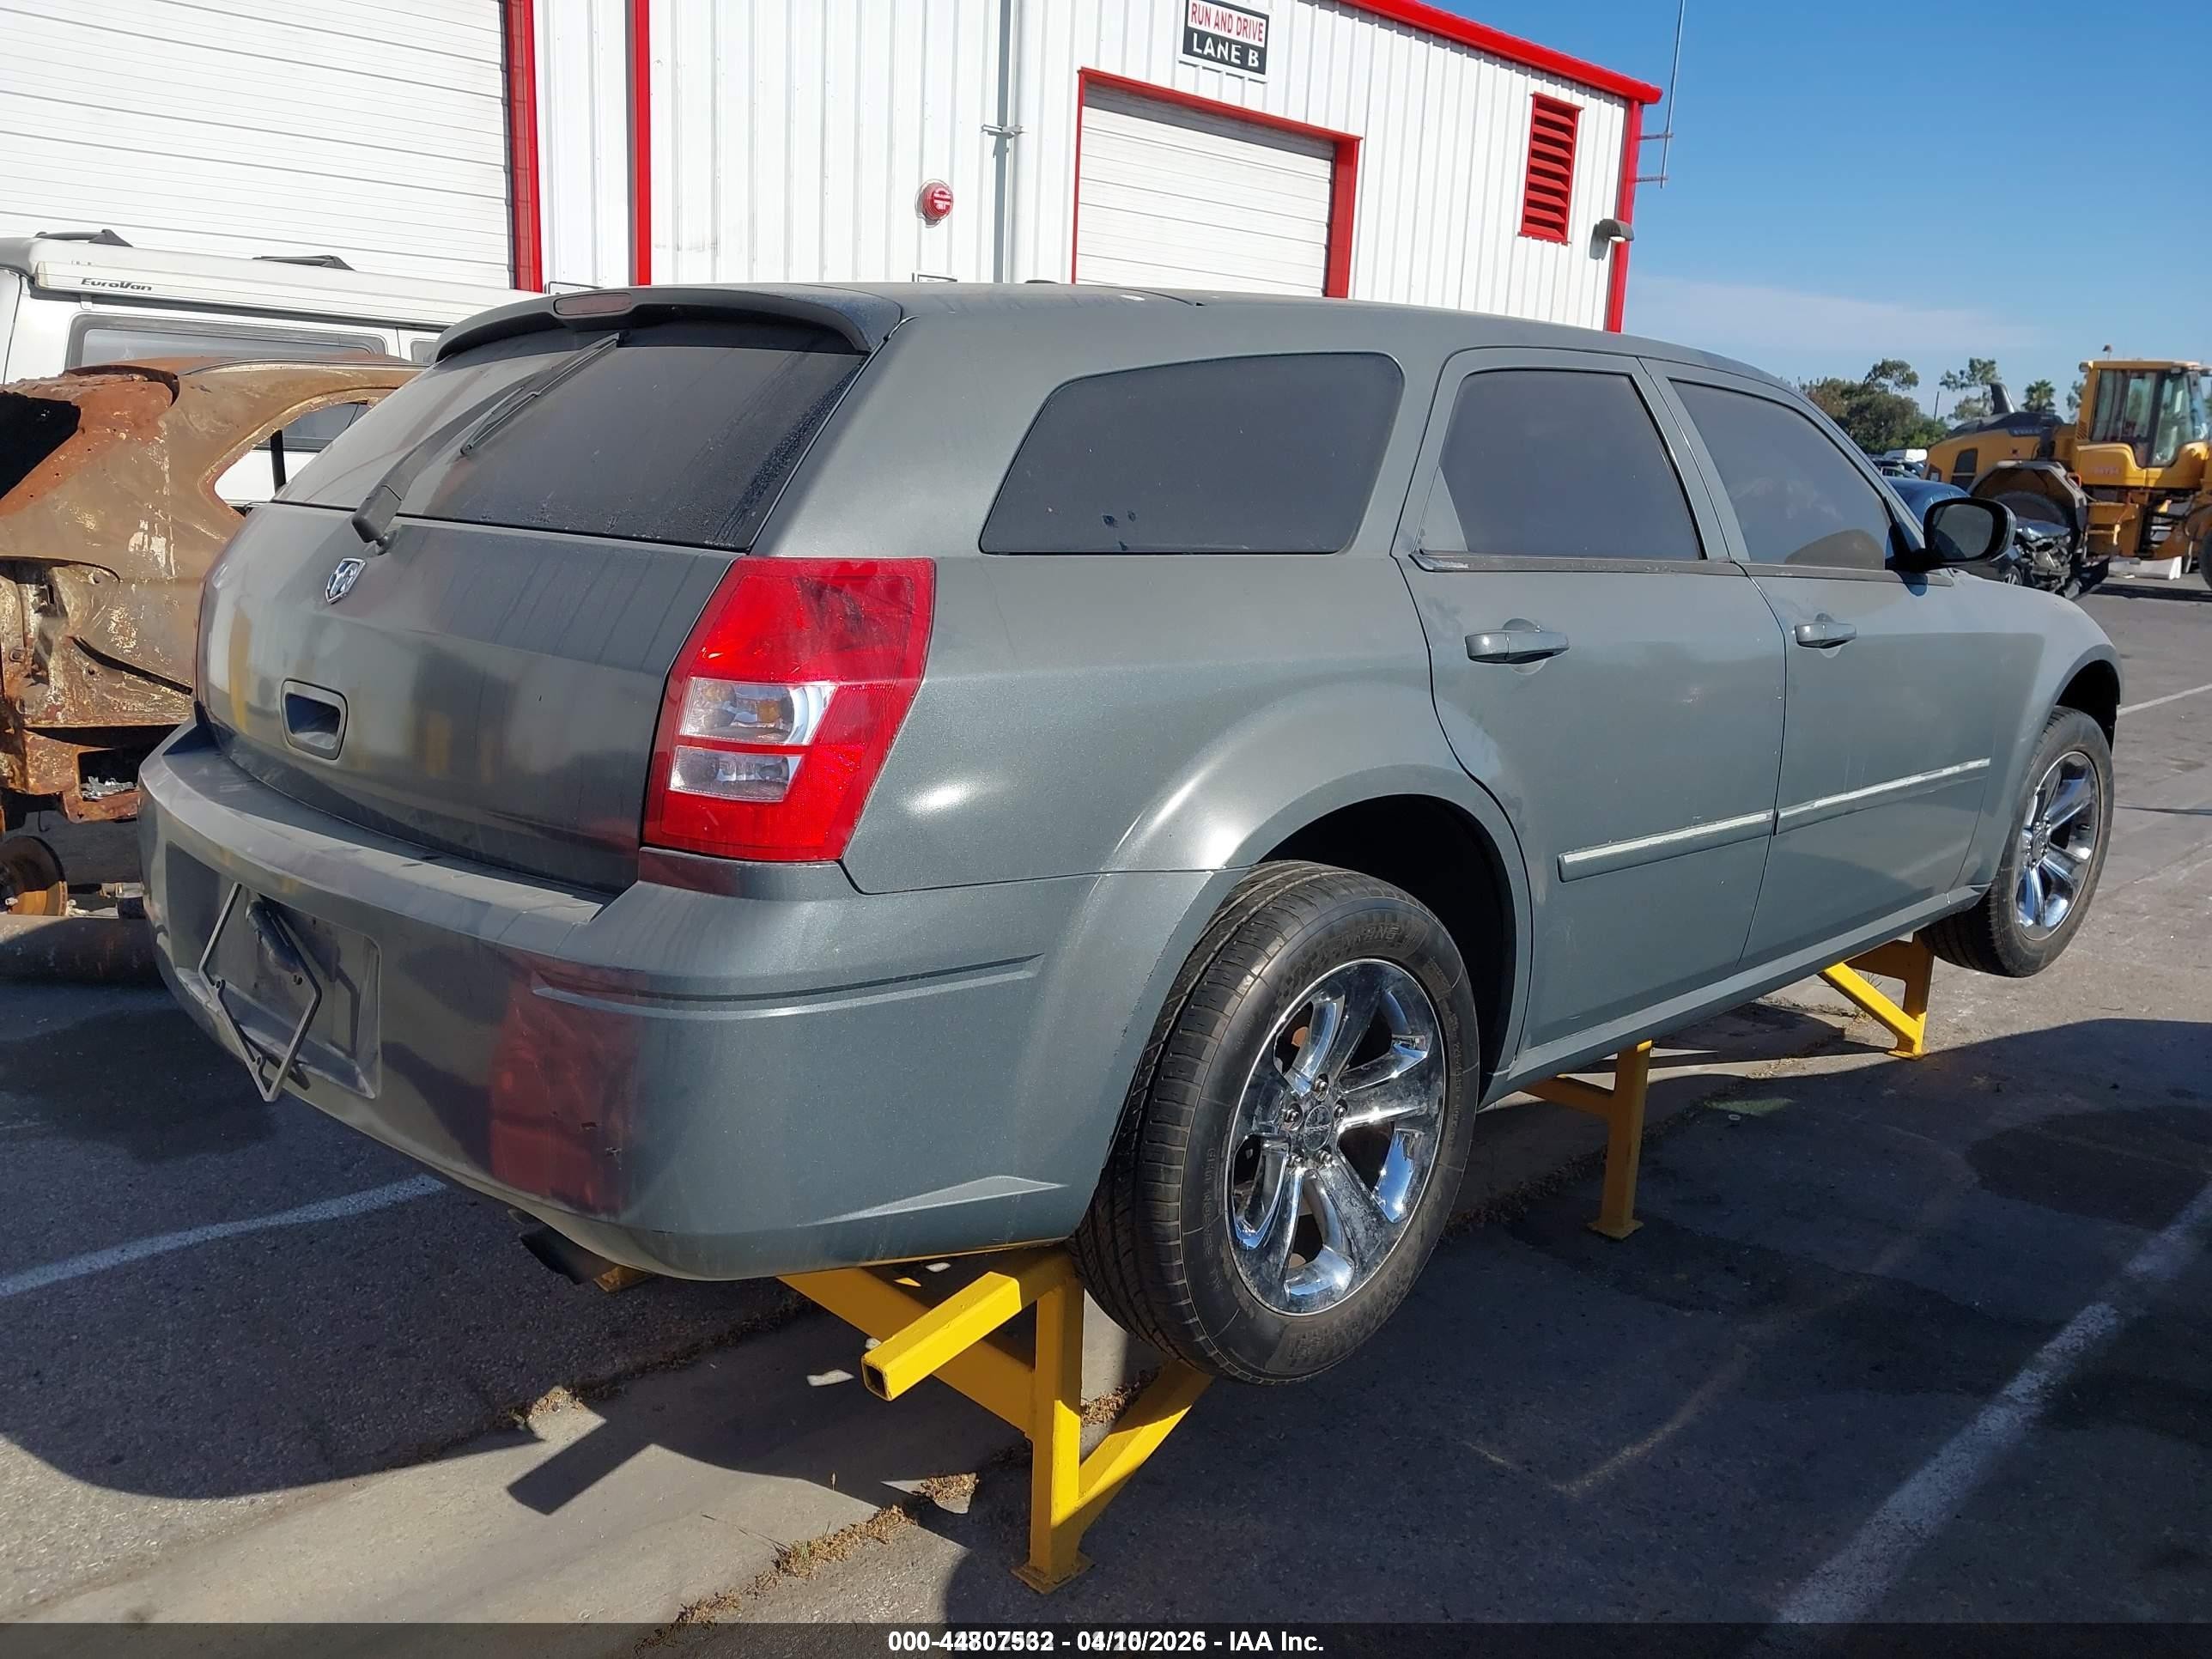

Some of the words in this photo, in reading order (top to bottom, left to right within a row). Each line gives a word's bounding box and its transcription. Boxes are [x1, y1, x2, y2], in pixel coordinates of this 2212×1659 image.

[1191, 3, 1212, 27] RUN
[1213, 9, 1233, 33] AND
[1236, 16, 1264, 42] DRIVE
[1193, 33, 1242, 64] LANE
[1248, 48, 1260, 67] B
[82, 278, 152, 291] EuroVan
